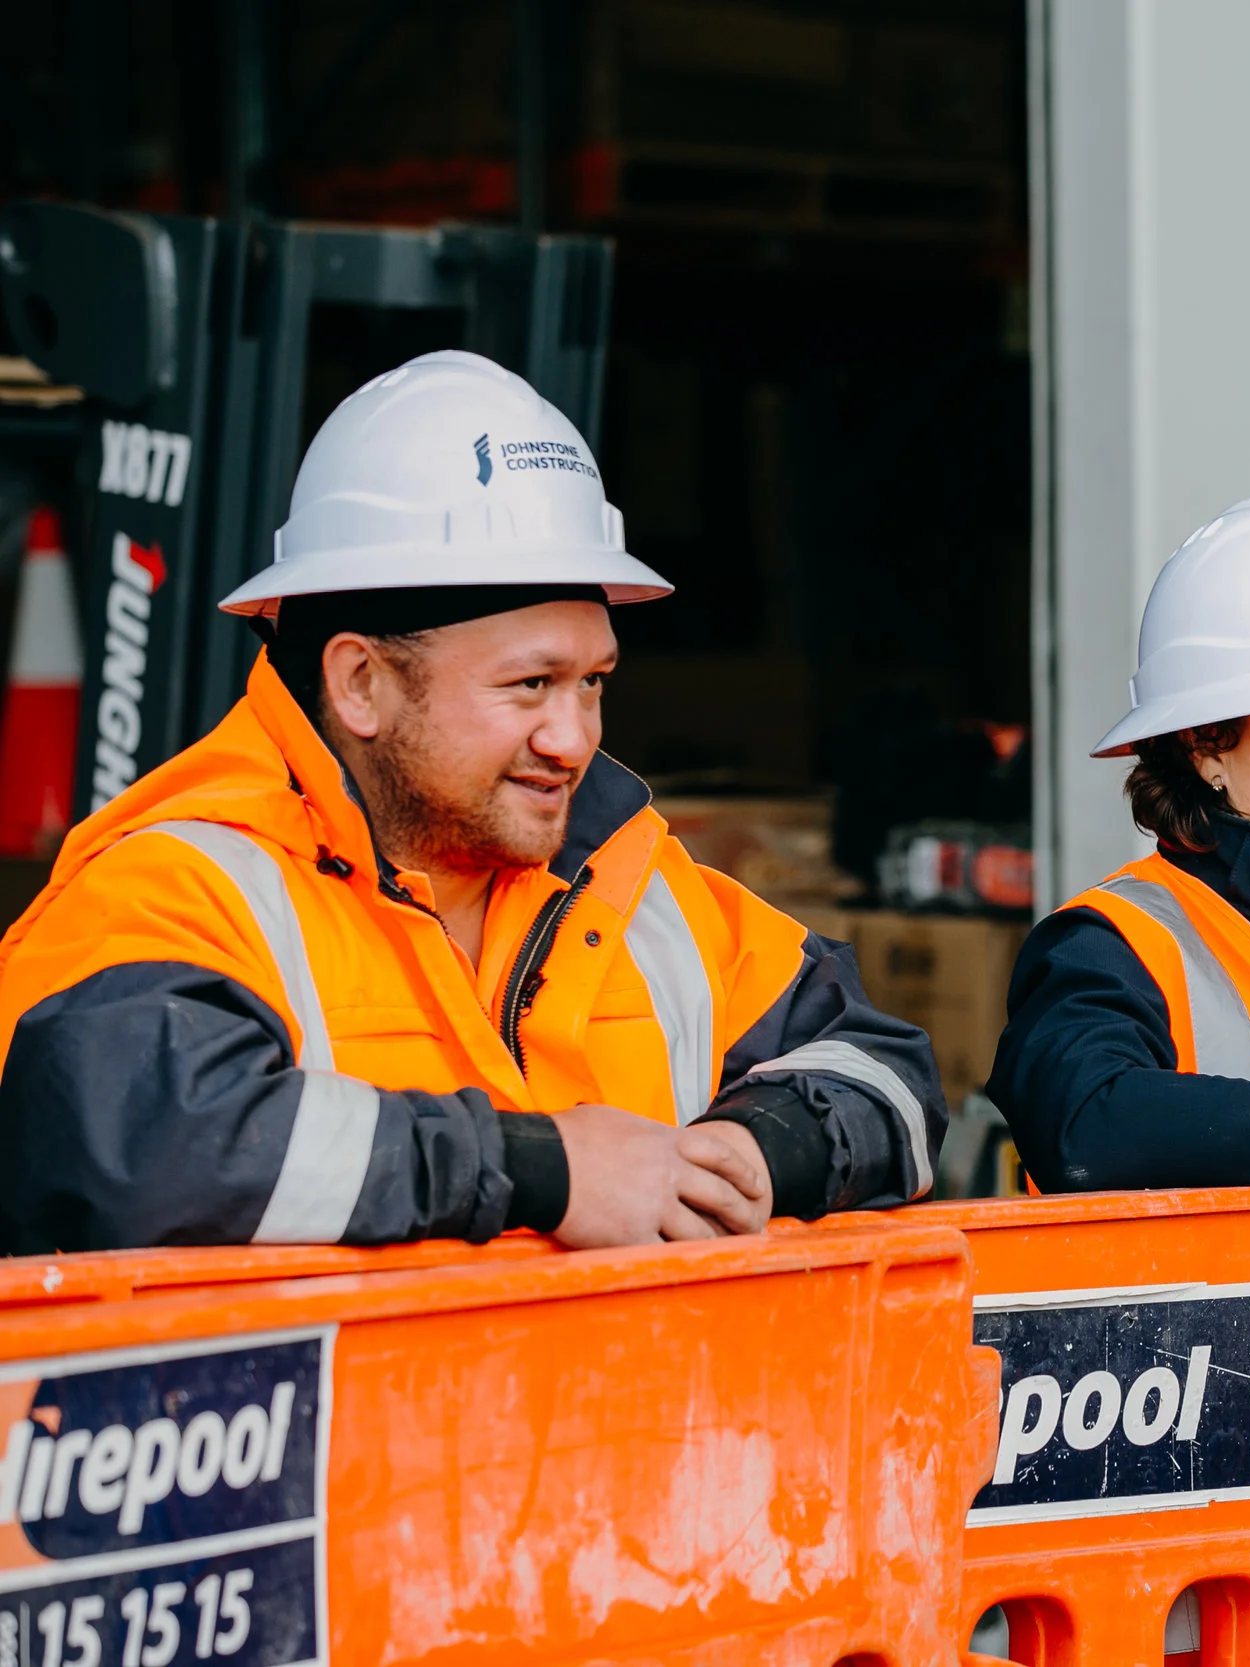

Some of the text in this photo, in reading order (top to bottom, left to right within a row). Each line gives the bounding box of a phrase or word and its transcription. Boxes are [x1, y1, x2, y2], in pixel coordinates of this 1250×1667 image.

[98, 418, 192, 508] X877
[501, 441, 581, 458] JOHNSTONE
[90, 530, 168, 815] JUNGH
[992, 1345, 1212, 1485] pool
[37, 1594, 105, 1667] 15
[121, 1580, 187, 1667] 15
[194, 1567, 254, 1660] 15
